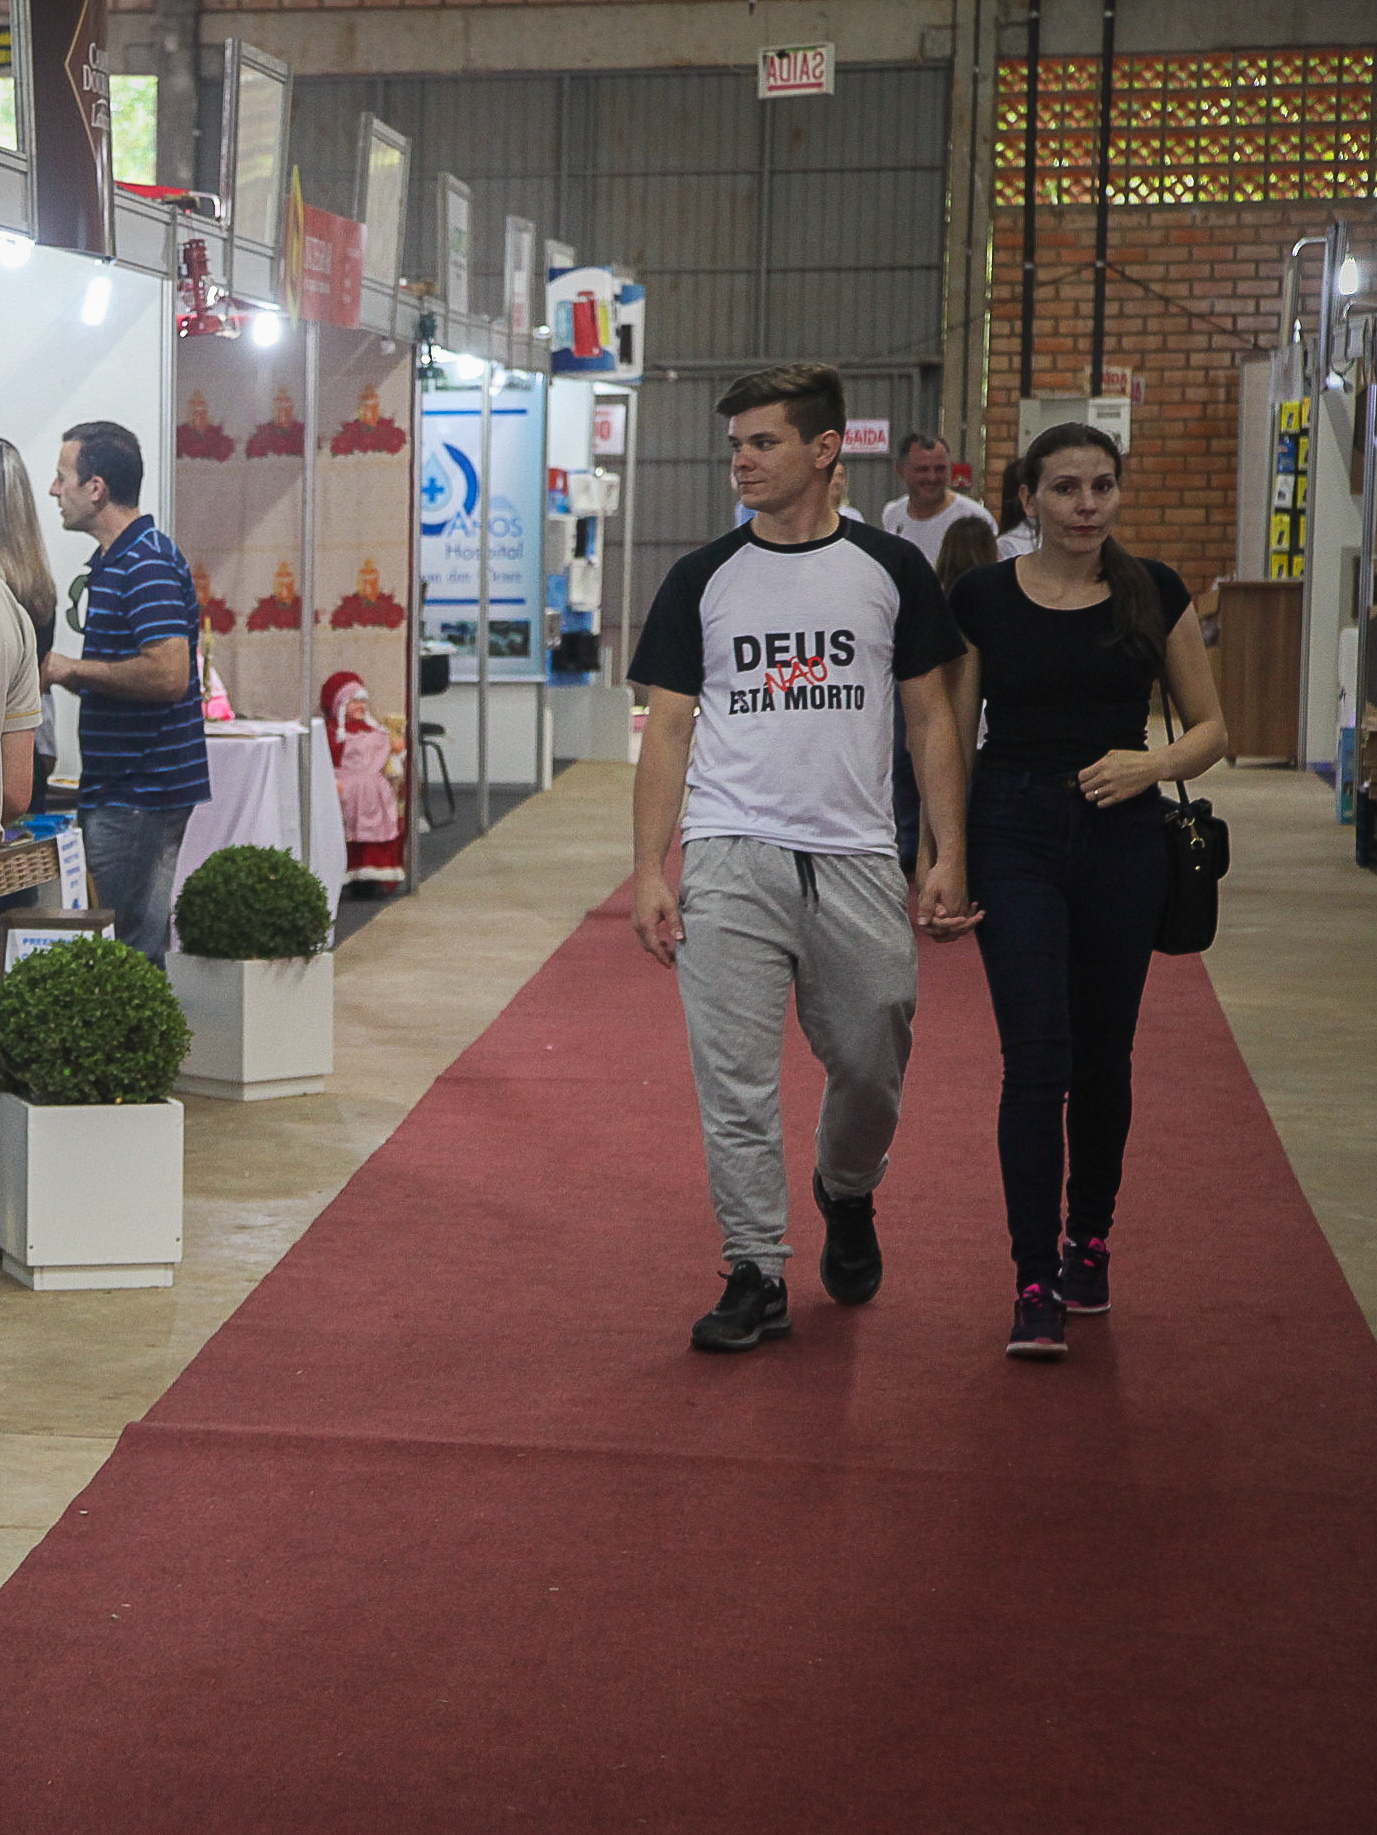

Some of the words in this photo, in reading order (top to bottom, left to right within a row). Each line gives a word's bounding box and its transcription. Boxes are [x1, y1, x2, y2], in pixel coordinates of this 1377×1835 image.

[733, 629, 856, 673] DEUS
[764, 655, 828, 694] NÃO
[728, 682, 775, 716] ESTÁ
[784, 684, 865, 711] MORTO
